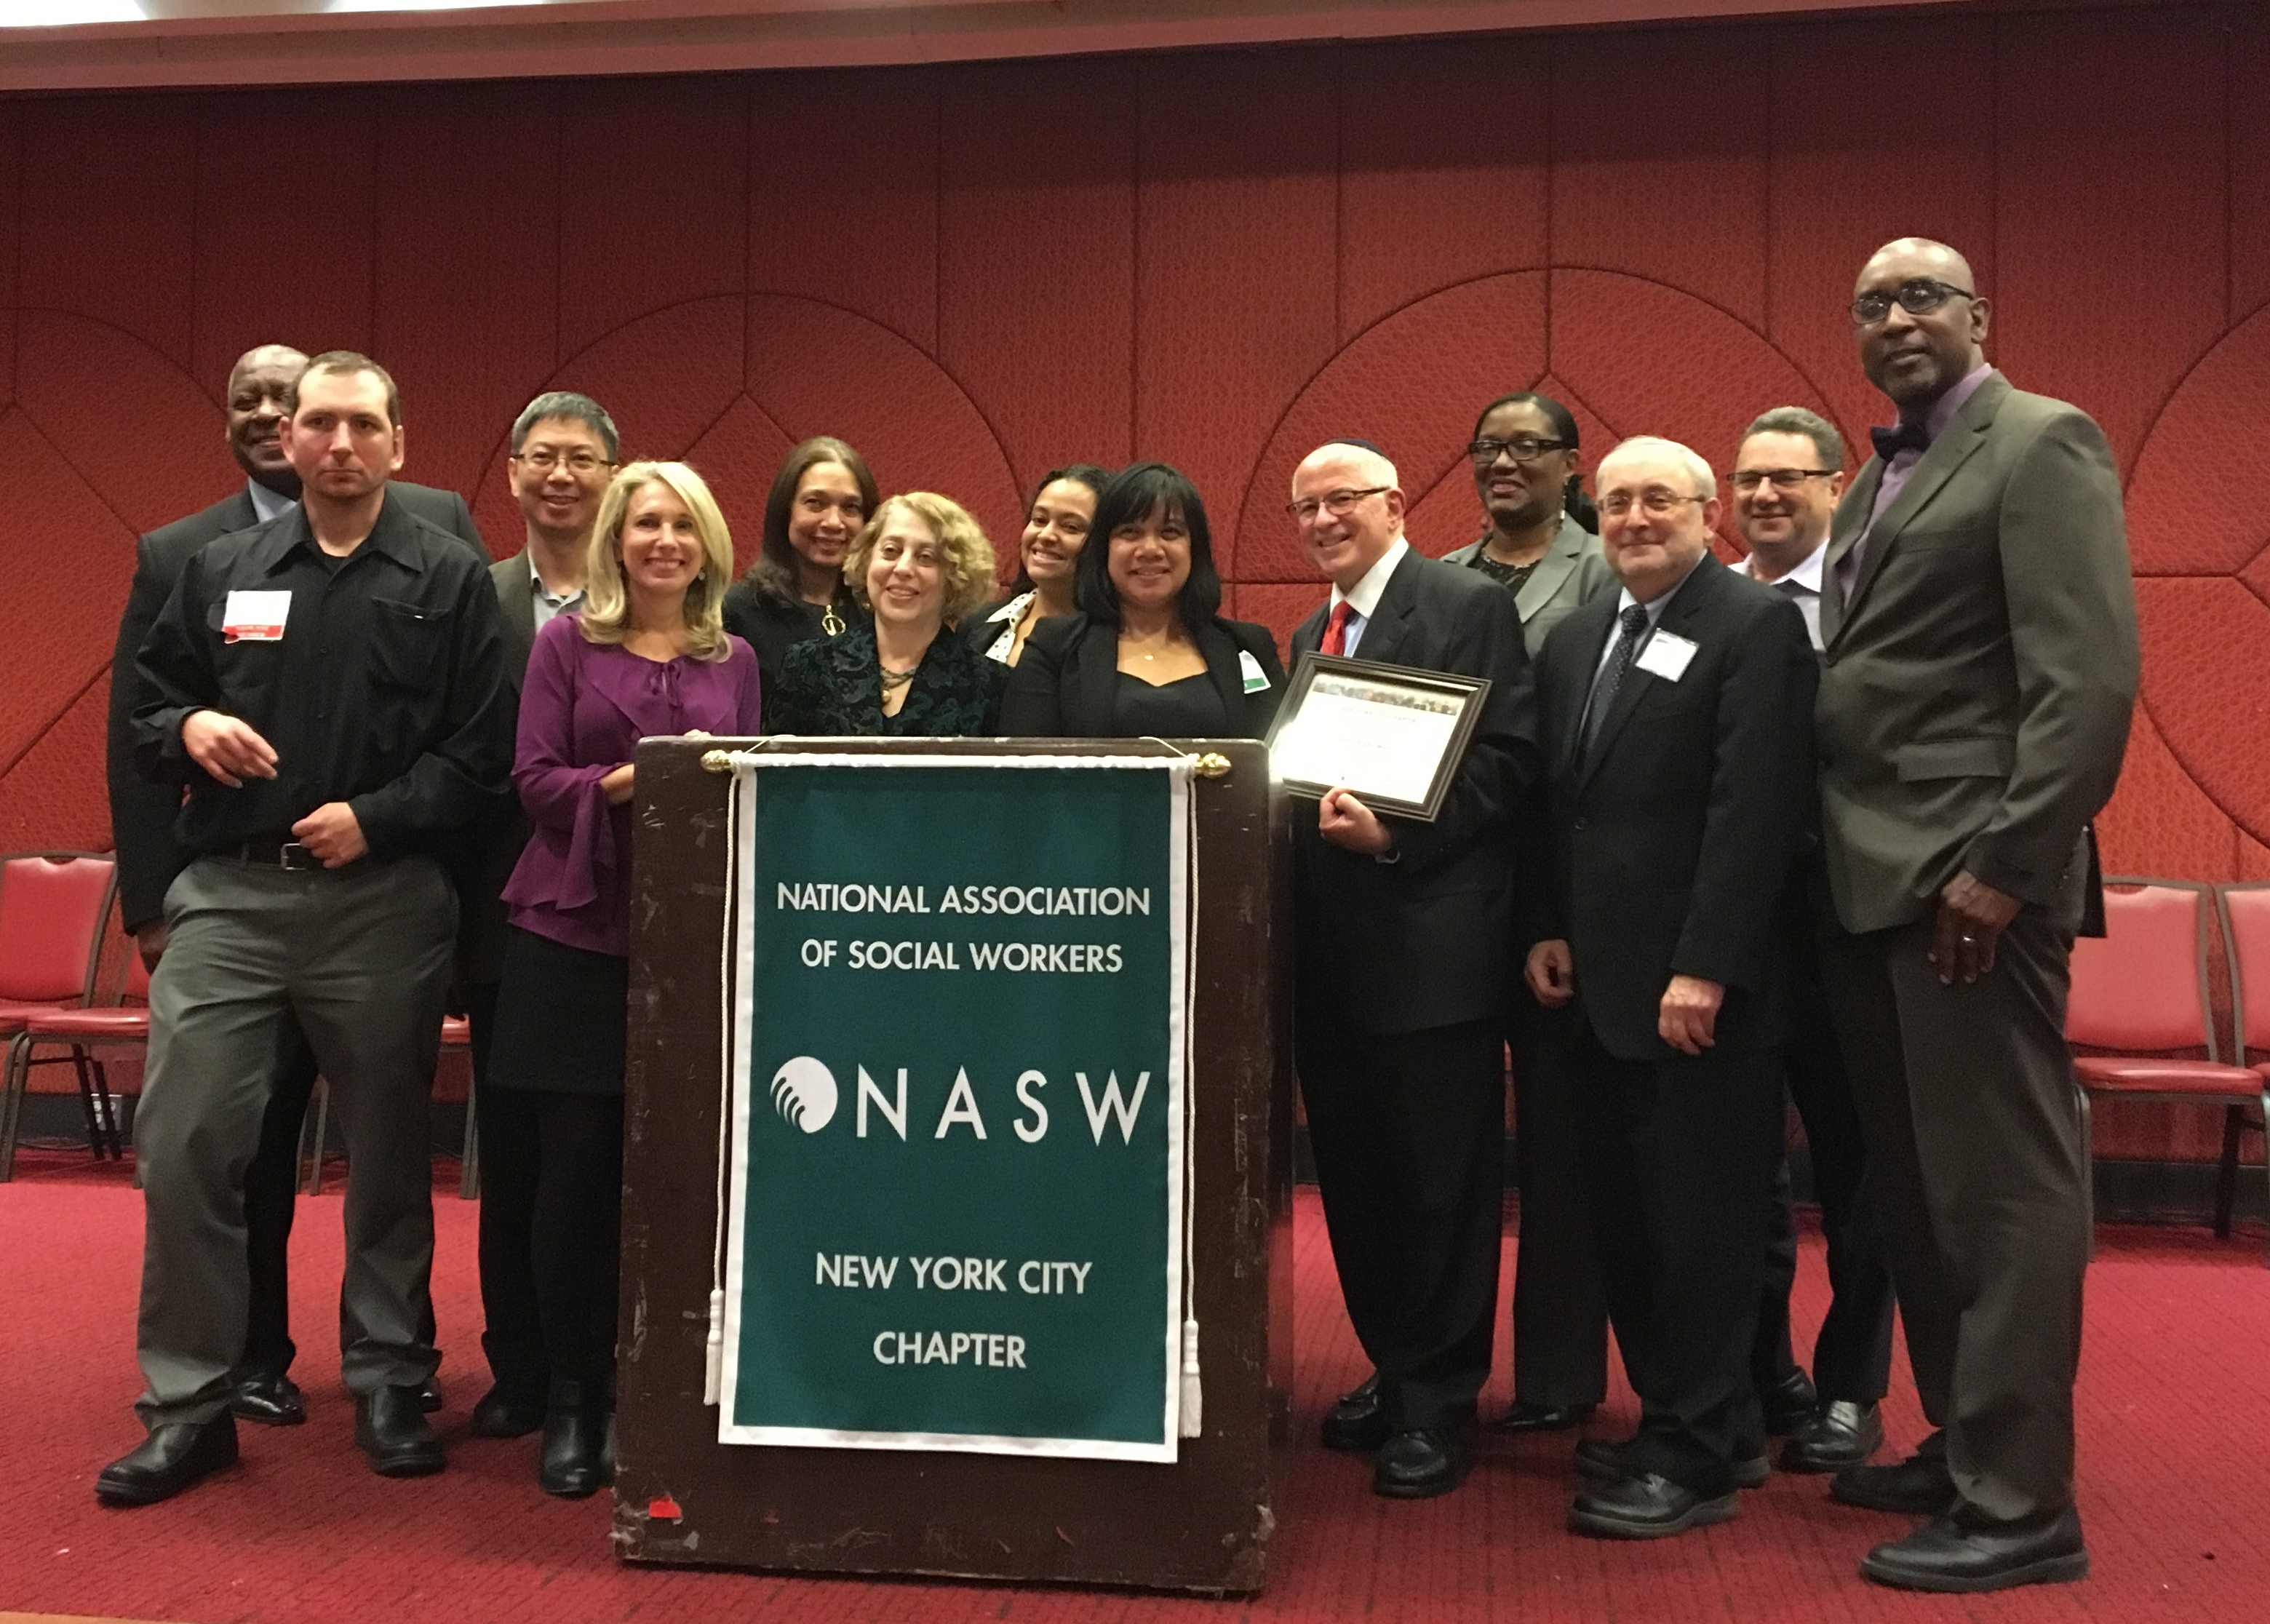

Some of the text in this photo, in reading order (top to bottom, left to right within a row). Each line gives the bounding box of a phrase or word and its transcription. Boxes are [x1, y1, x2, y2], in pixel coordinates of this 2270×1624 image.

[778, 882, 1150, 916] NATIONAL ASSOCIATION
[801, 939, 1123, 972] OF SOCIAL WORKERS
[856, 1064, 1150, 1146] NASW
[816, 1252, 1093, 1294] NEW YORK CITY
[873, 1331, 1027, 1368] CHAPTER
